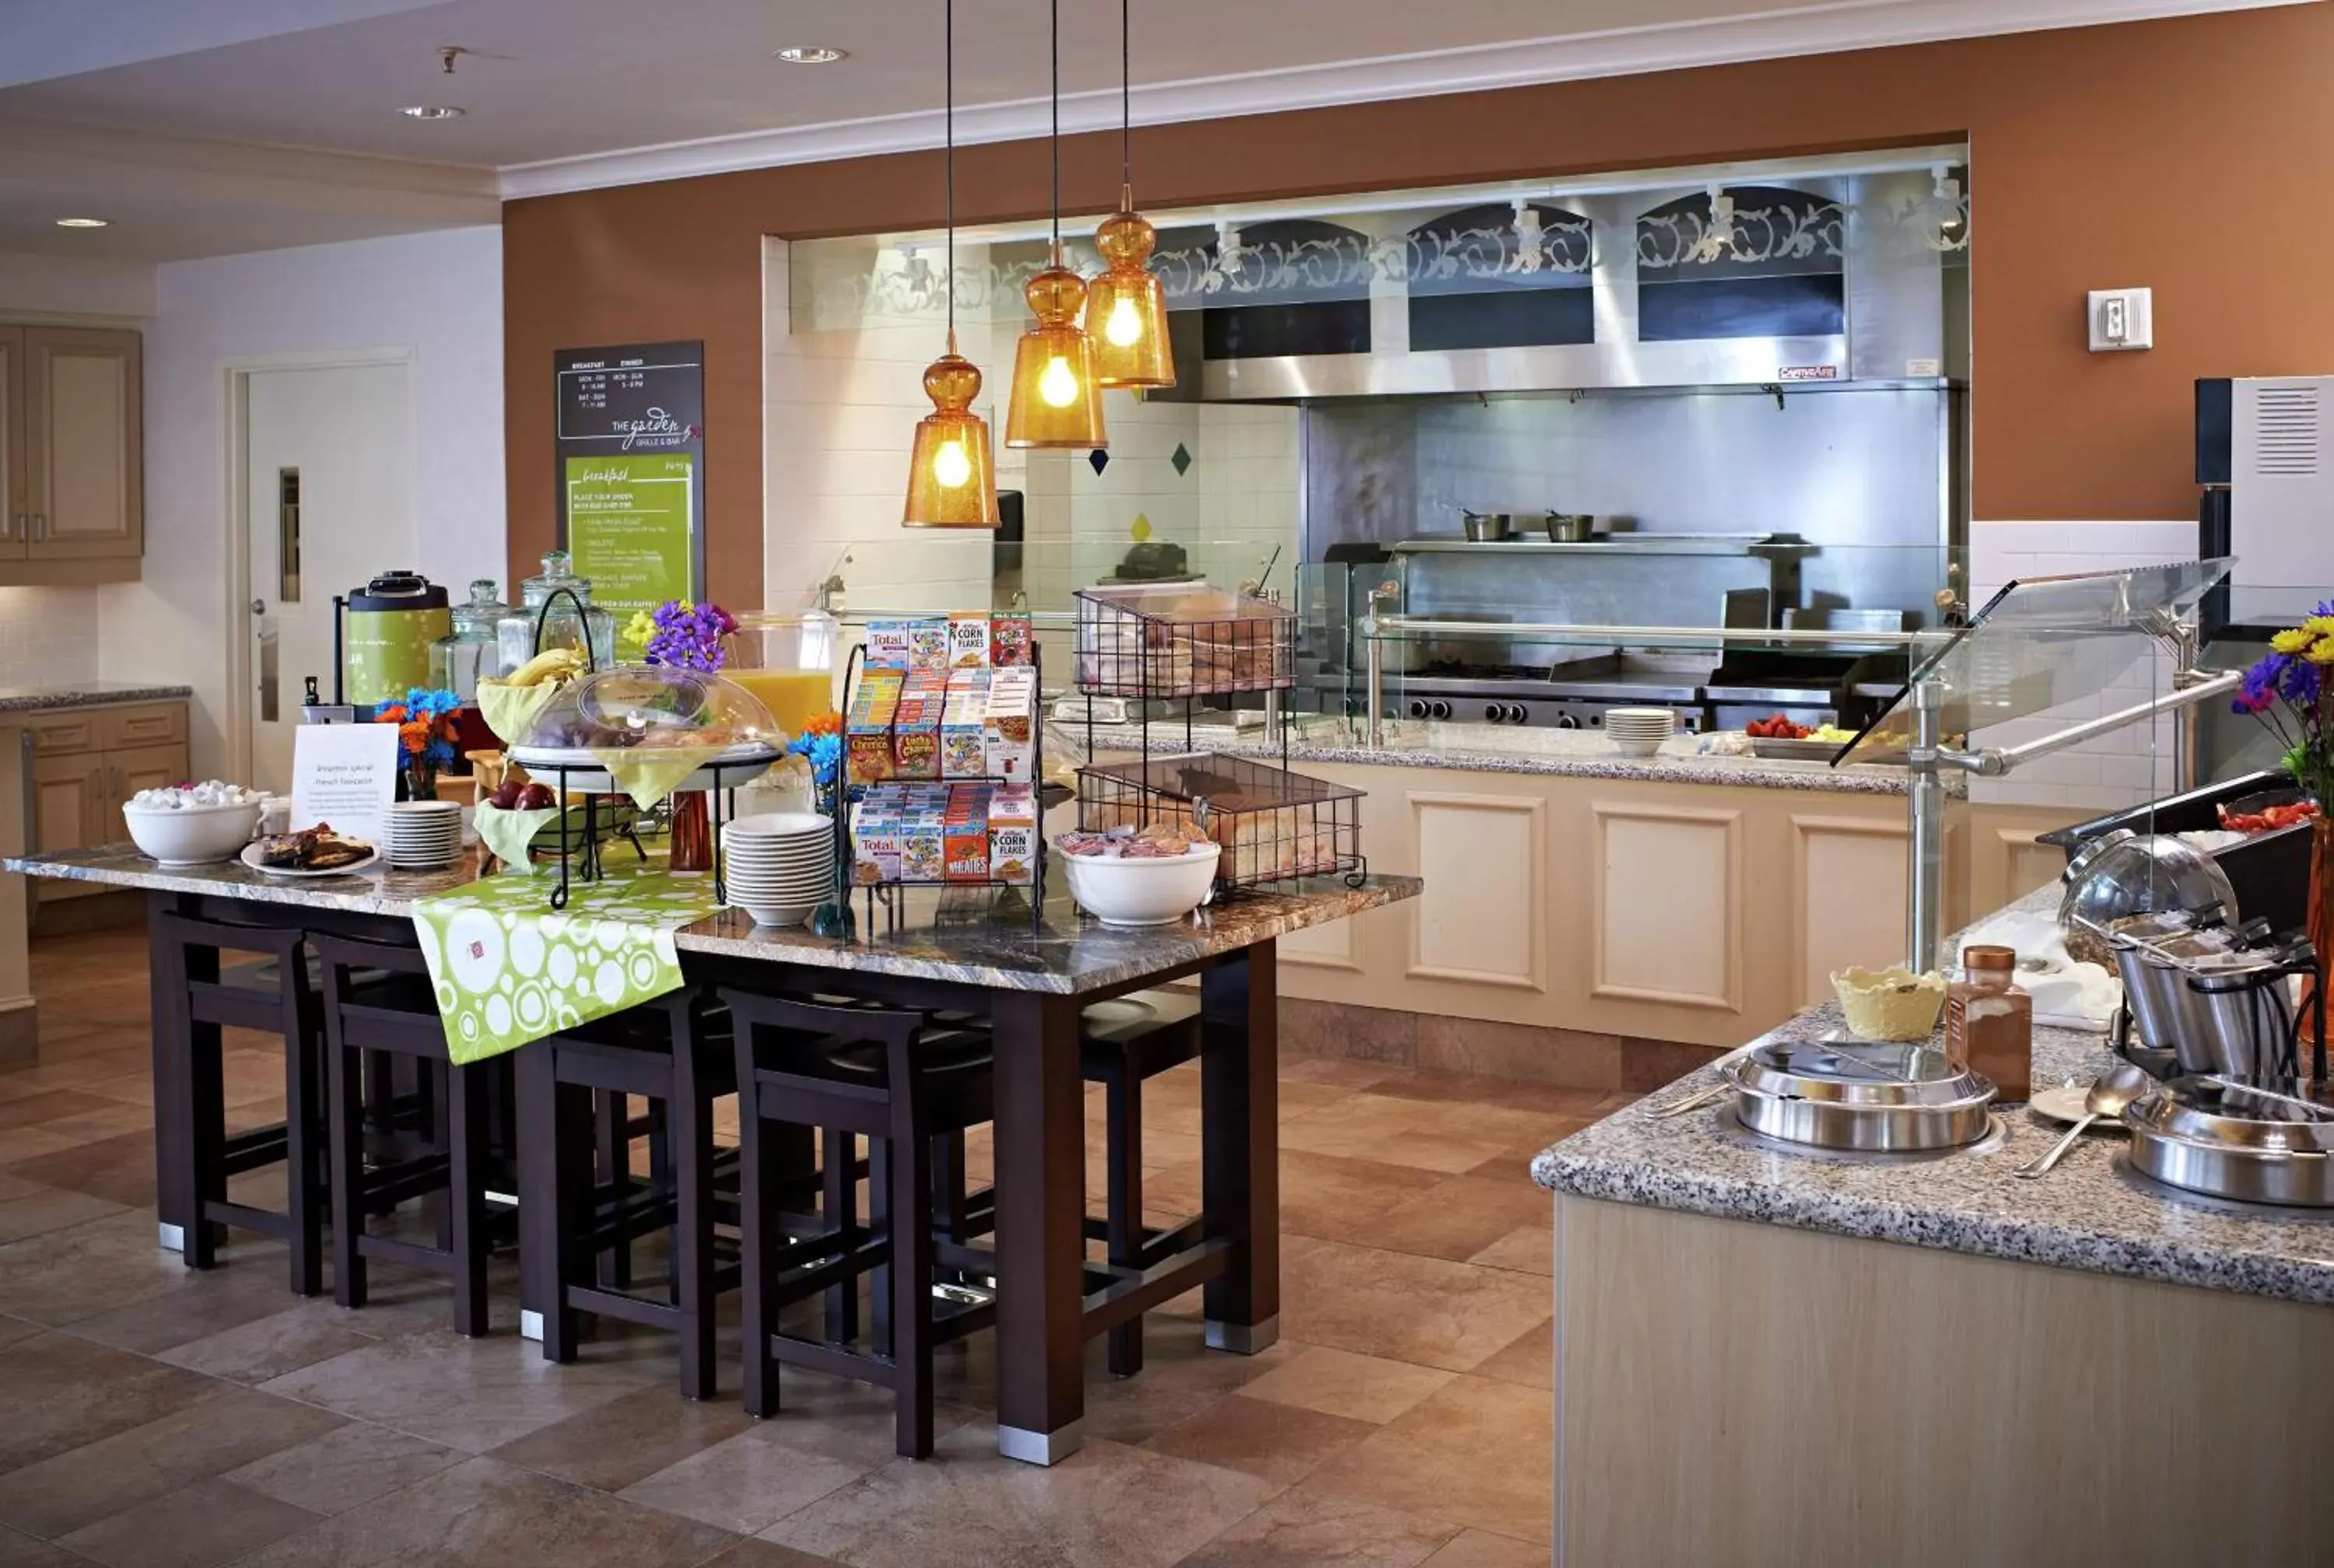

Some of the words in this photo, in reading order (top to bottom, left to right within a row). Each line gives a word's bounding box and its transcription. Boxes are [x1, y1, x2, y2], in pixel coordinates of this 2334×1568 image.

[612, 421, 629, 432] THE
[622, 407, 679, 450] garden
[666, 437, 681, 446] BAR
[958, 628, 983, 639] CORN
[871, 634, 902, 645] Total
[958, 639, 984, 648] FLAKES
[862, 839, 895, 850] Total
[1000, 836, 1026, 845] CORN
[1000, 845, 1026, 854] FLAKES
